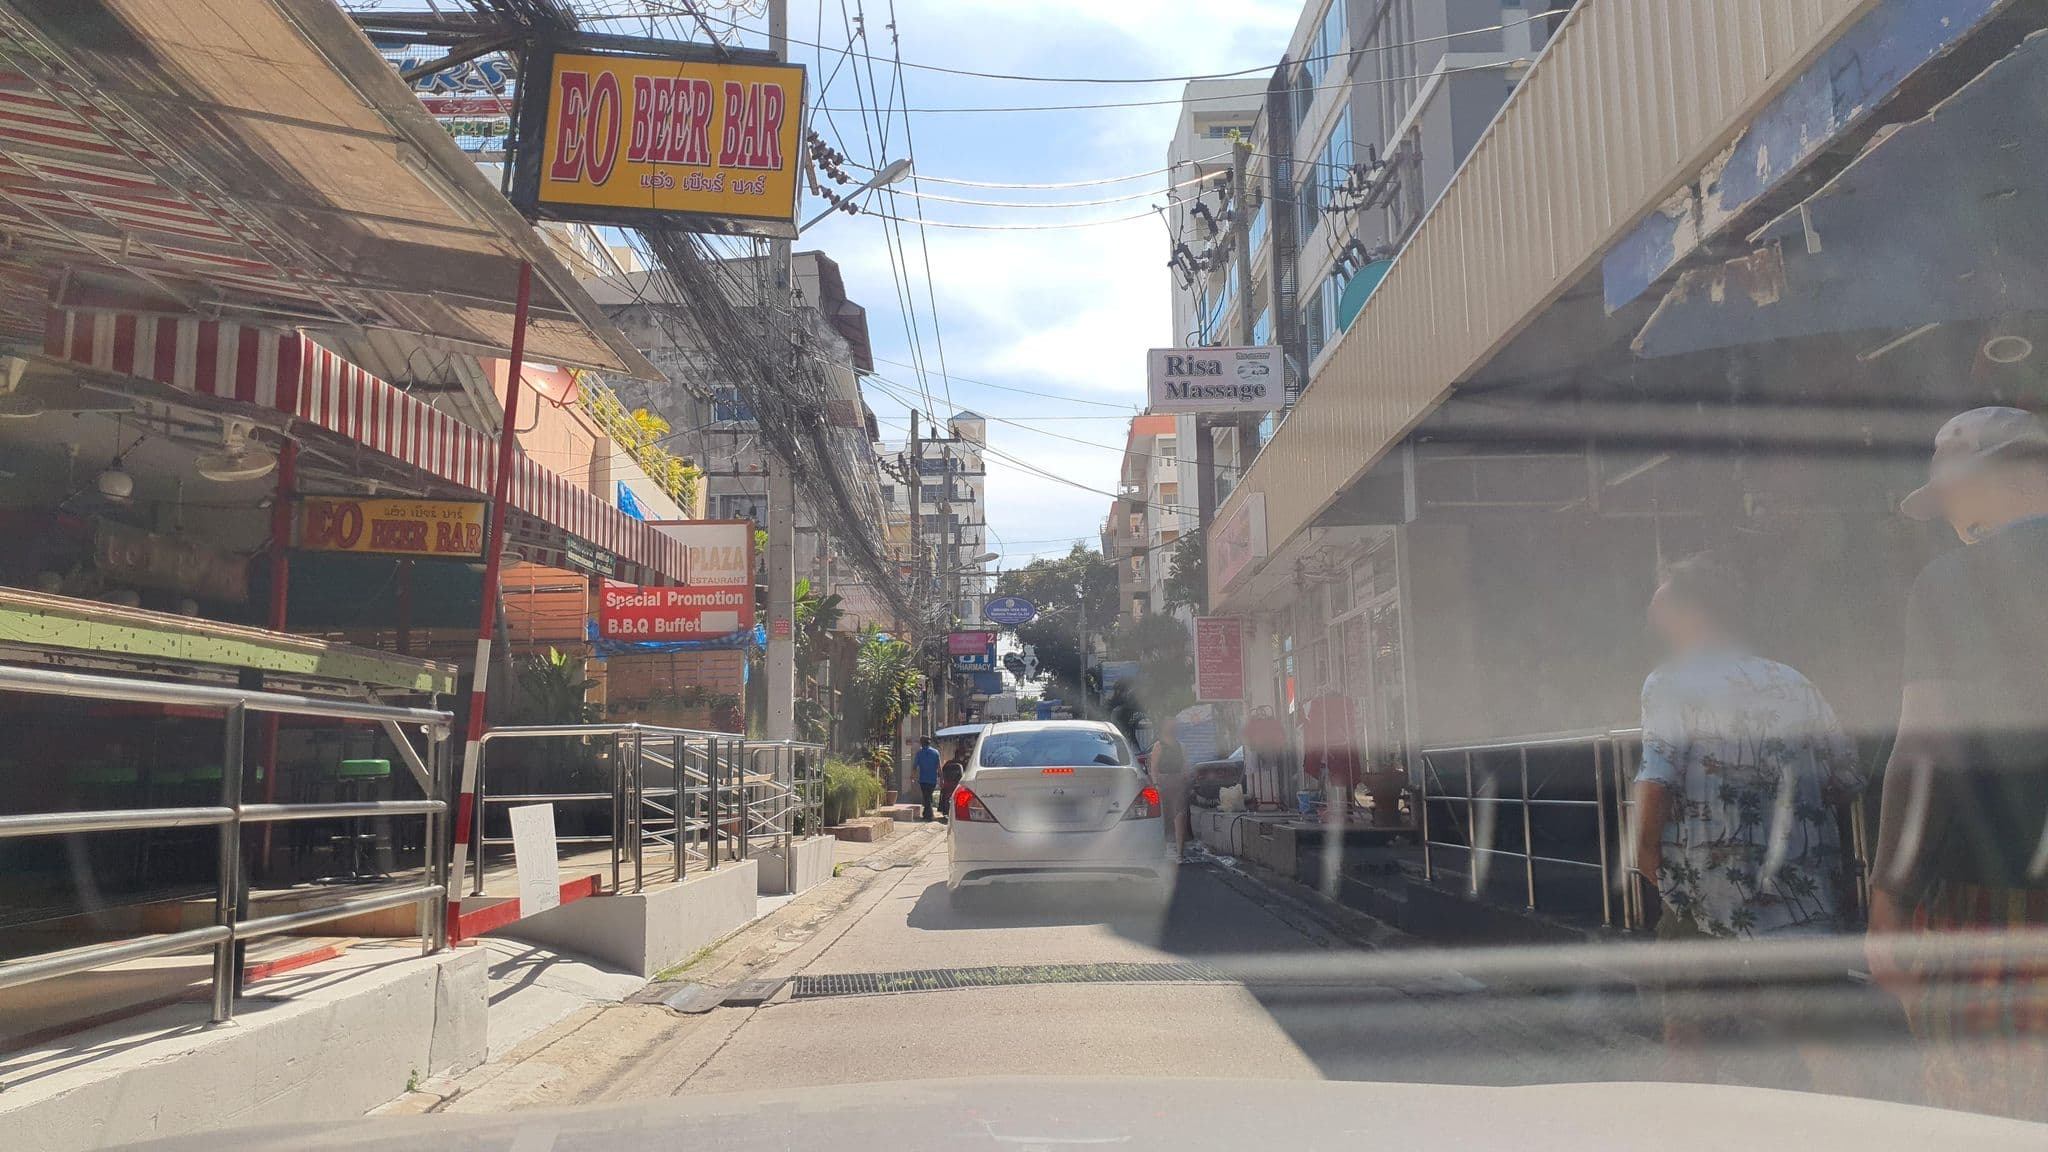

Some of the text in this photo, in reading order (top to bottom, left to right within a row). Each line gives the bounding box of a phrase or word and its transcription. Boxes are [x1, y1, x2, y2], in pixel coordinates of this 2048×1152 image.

[551, 70, 785, 185] EO BEER BAR
[683, 172, 725, 193] เบียร์
[732, 175, 766, 195] บาร์
[1164, 354, 1223, 377] Risa
[1164, 381, 1267, 402] Massage
[305, 502, 481, 554] EO BEER BAR
[691, 546, 745, 571] PLAZA
[606, 591, 743, 609] Special Promotion
[608, 618, 701, 634] B.B.Q Buffet
